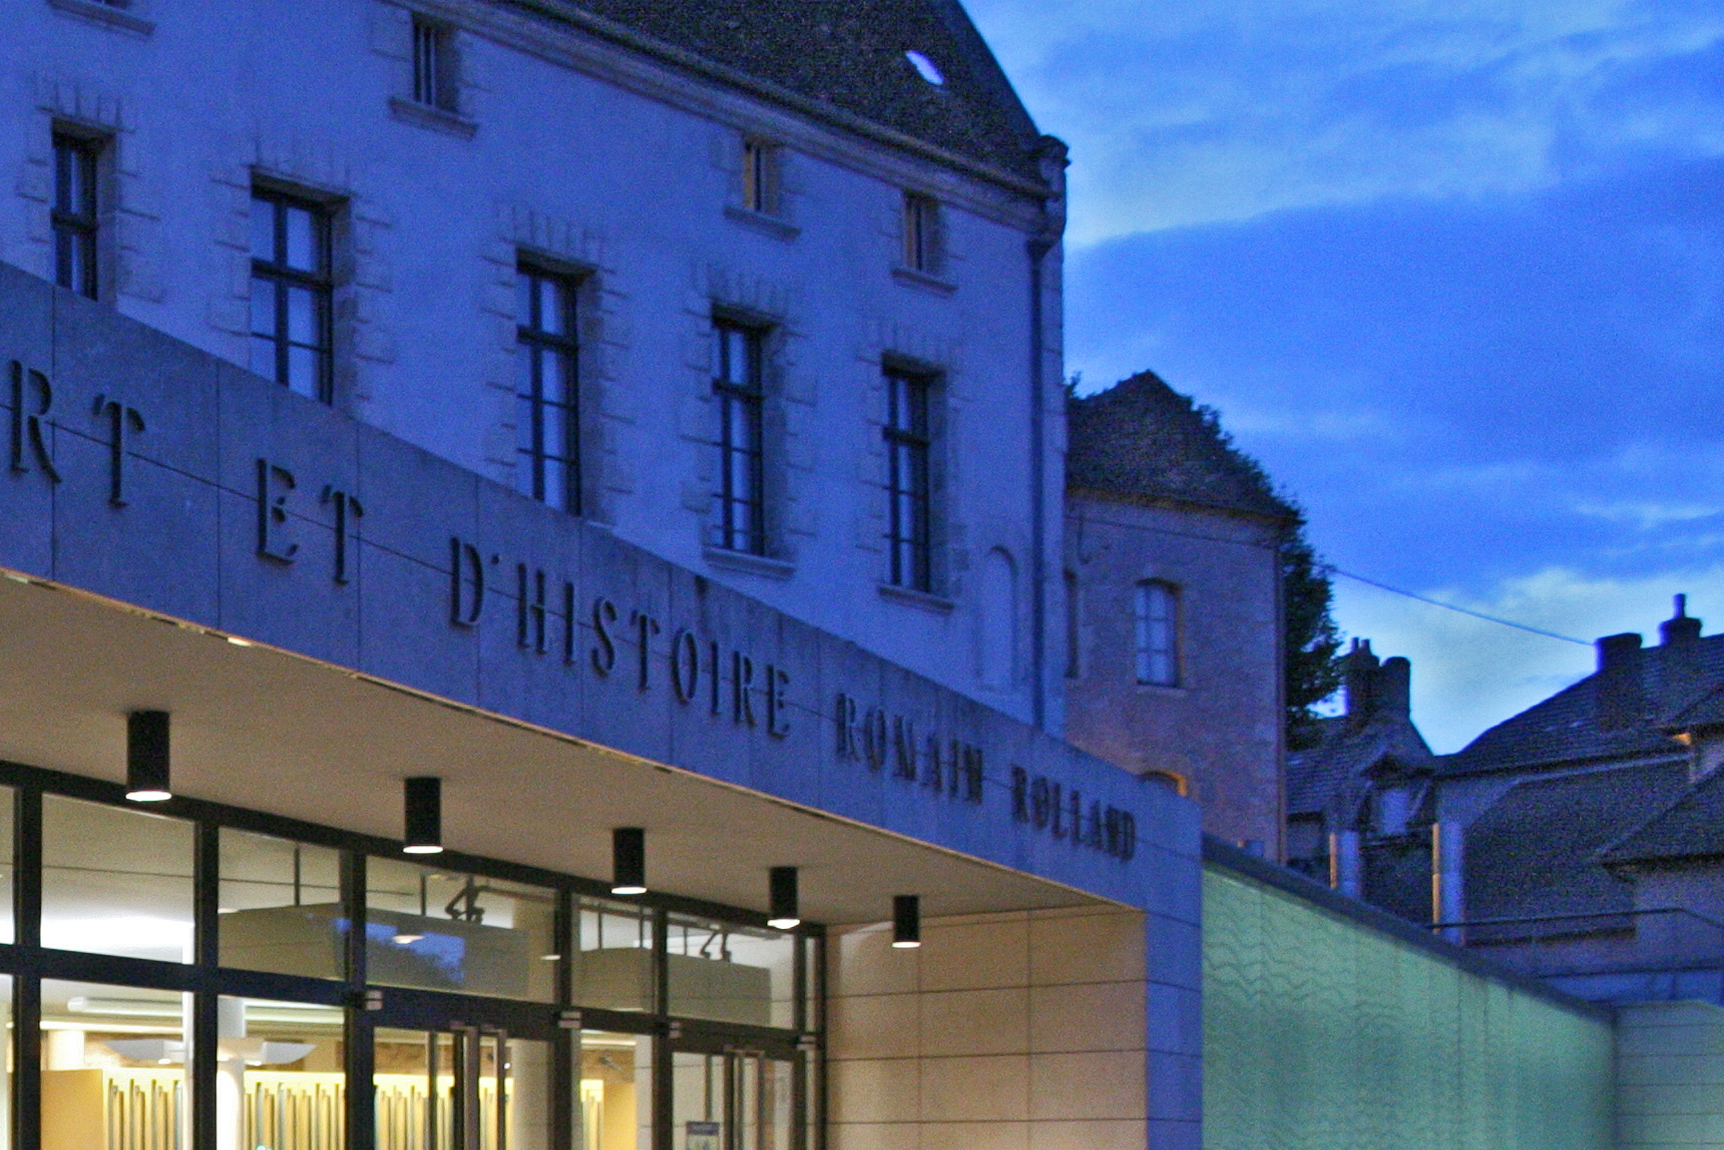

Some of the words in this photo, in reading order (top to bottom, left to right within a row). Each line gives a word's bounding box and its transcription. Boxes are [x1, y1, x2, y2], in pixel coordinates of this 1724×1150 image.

[256, 458, 364, 585] ET
[449, 536, 791, 740] D'HISTOIRE
[835, 692, 984, 806] ROMAIN
[1011, 763, 1136, 862] ROLLAND
